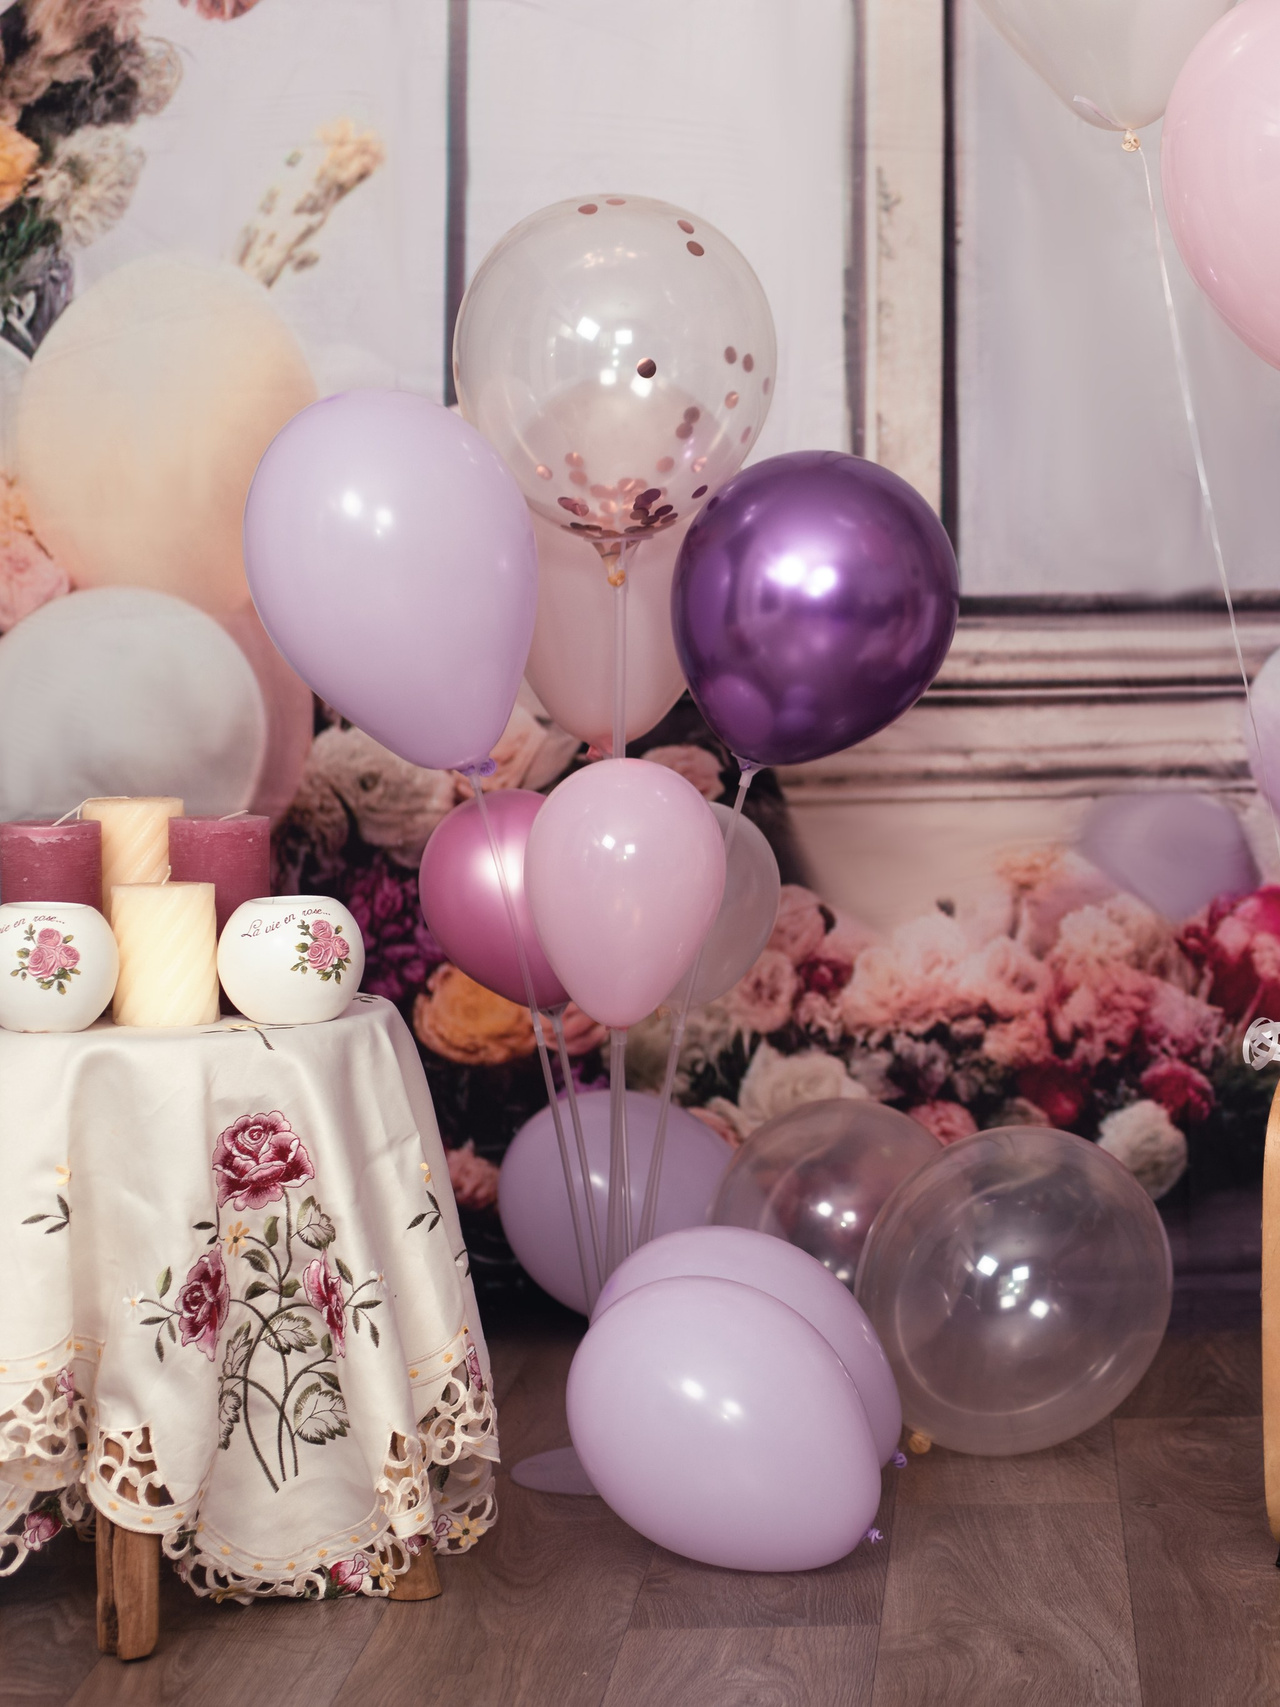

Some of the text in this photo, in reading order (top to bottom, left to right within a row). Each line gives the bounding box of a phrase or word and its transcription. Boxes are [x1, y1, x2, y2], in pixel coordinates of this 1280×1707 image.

[0, 924, 10, 934] ie
[13, 918, 26, 928] en
[240, 908, 331, 938] La vie en rose...
